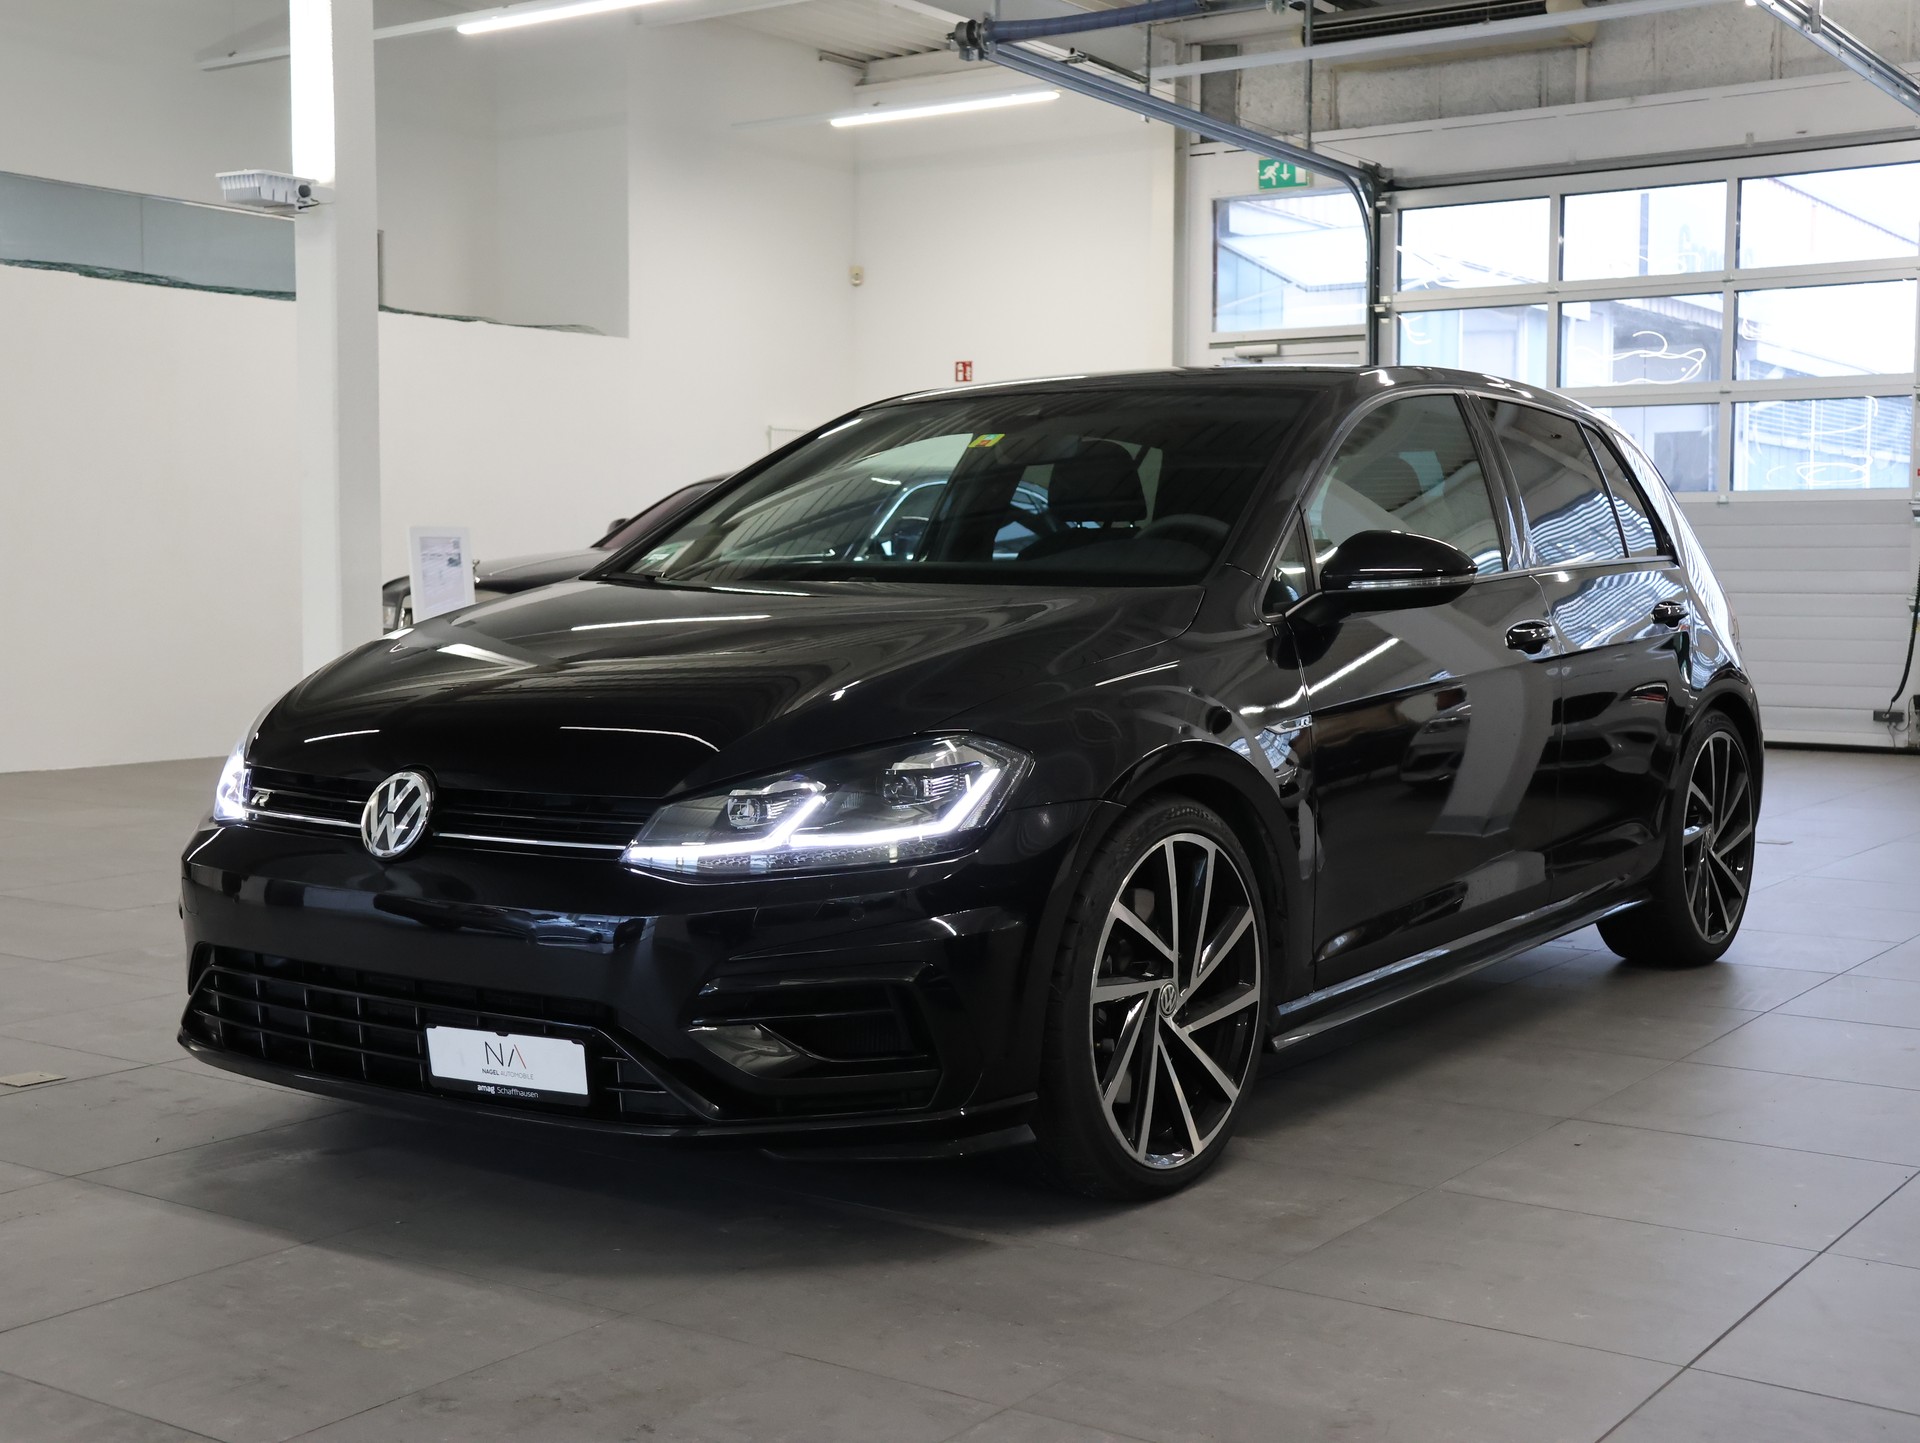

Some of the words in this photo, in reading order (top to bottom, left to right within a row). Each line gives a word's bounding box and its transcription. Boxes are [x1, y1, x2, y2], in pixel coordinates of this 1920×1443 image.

[251, 790, 272, 807] R
[361, 771, 433, 857] VW
[482, 1068, 500, 1077] NAGEL
[500, 1070, 534, 1080] AUTOMOBILE
[477, 1084, 495, 1094] amag
[497, 1086, 539, 1098] Schaffhausen
